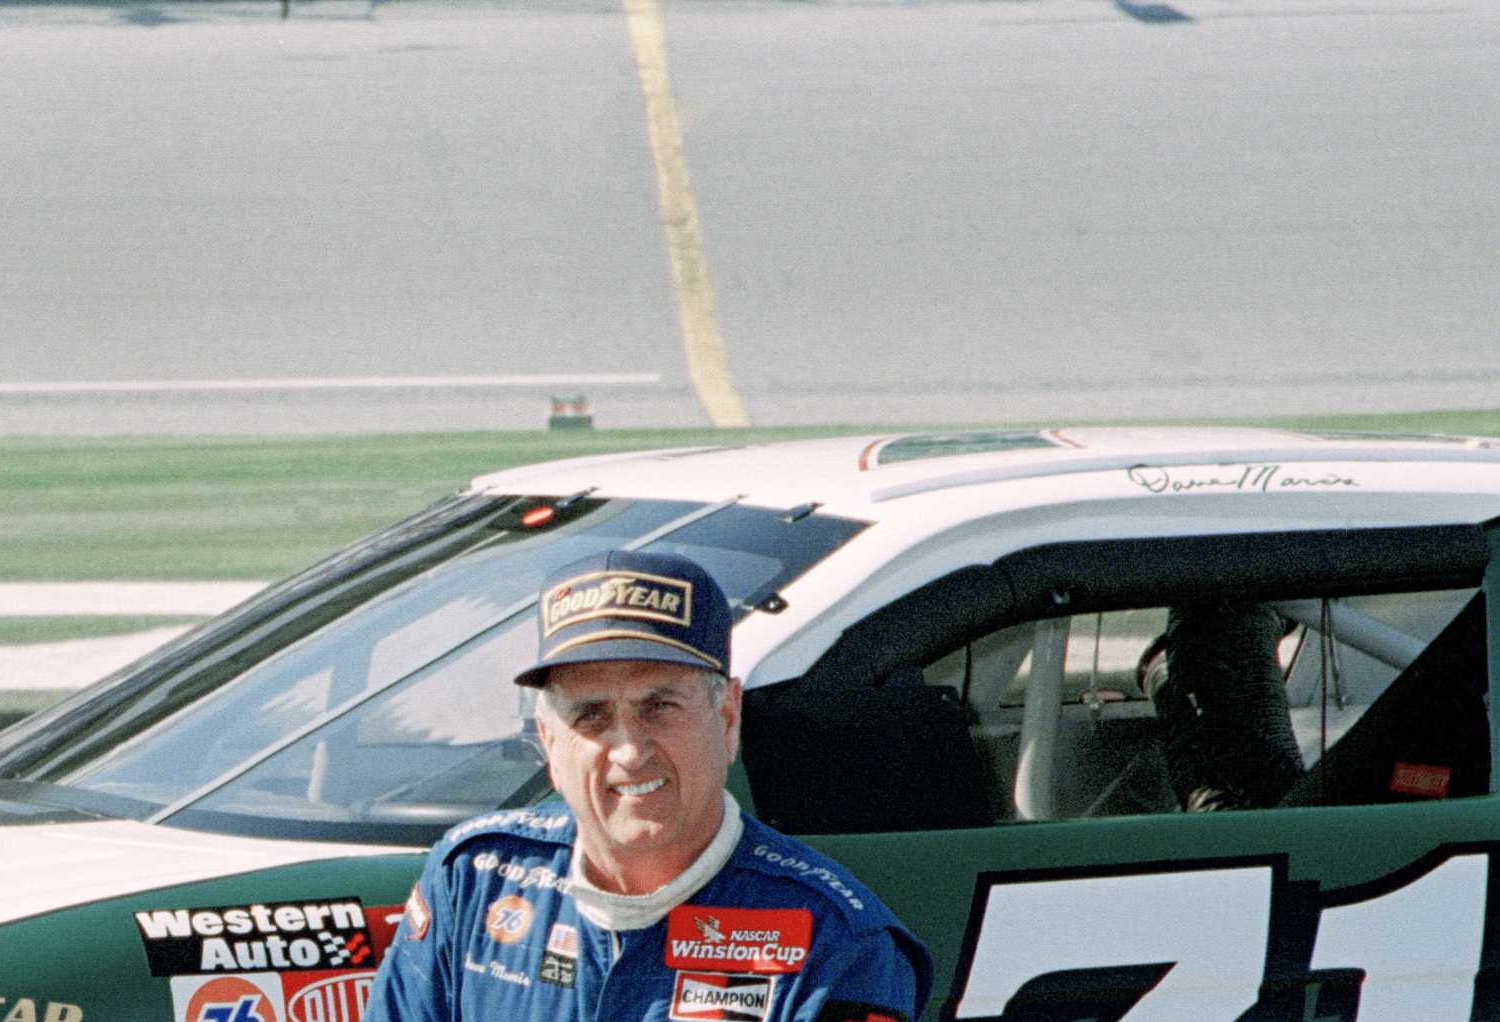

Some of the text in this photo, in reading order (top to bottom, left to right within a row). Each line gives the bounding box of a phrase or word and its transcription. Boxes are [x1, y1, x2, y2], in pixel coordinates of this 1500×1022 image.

[551, 578, 680, 623] GOODYEAR
[136, 903, 366, 939] Western
[729, 930, 781, 942] NASCAR
[201, 935, 321, 971] Auto
[682, 988, 766, 1009] CHAMPION
